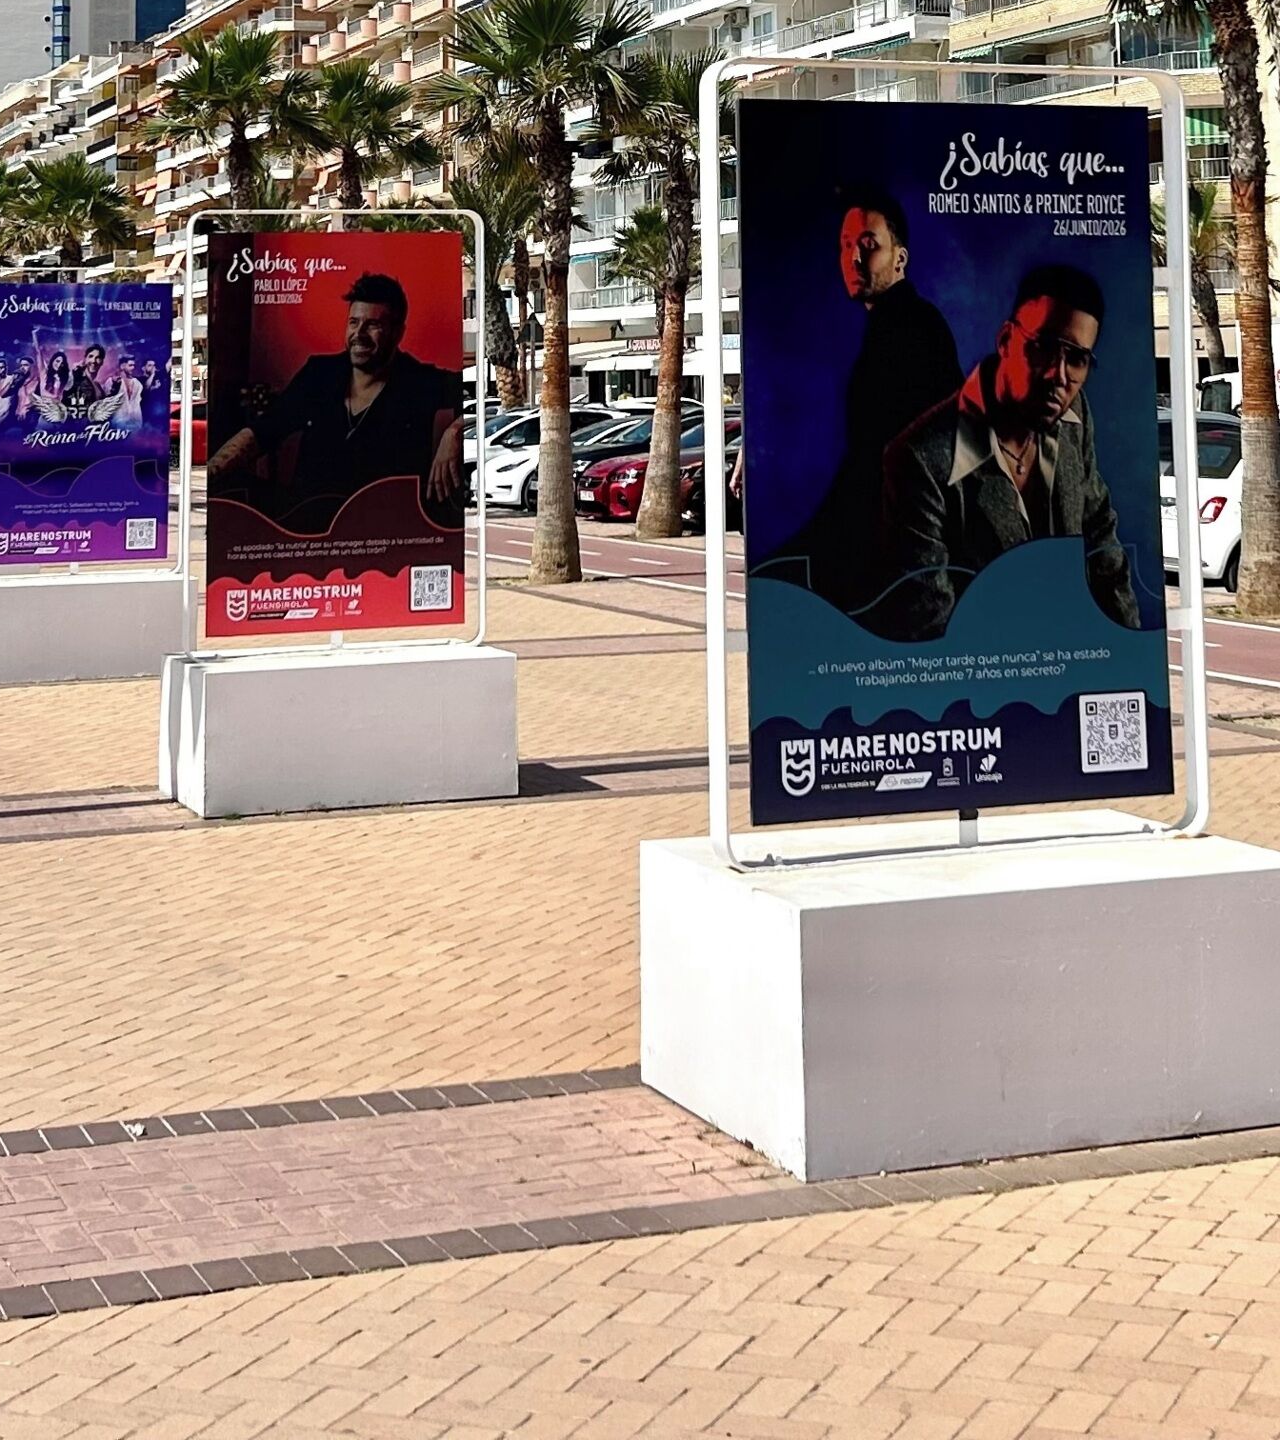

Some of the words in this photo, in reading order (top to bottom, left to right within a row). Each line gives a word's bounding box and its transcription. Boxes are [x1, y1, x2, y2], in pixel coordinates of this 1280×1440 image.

[939, 132, 1050, 191] ¿Sabías
[1059, 151, 1125, 185] que...
[928, 192, 970, 214] ROMEO
[972, 193, 1021, 214] SANTOS
[1023, 194, 1034, 214] &
[1036, 194, 1084, 215] PRINCE
[1087, 194, 1126, 215] ROYCE
[1053, 219, 1127, 236] 26/JUNIO/2026
[226, 247, 297, 283] ¿Sabías
[304, 257, 347, 278] que...
[254, 279, 280, 292] PABLO
[281, 277, 308, 292] LÓPEZ
[84, 421, 131, 447] Flow
[818, 662, 828, 674] el
[831, 661, 866, 673] nuevo
[945, 654, 975, 667] tarde
[977, 656, 1000, 666] que
[1042, 652, 1055, 661] se
[1057, 649, 1071, 661] ha
[1073, 647, 1111, 659] estado
[855, 671, 917, 687] trabajando
[919, 670, 964, 683] durante
[966, 668, 973, 680] 7
[975, 667, 1002, 680] años
[1004, 667, 1019, 678] en
[1020, 663, 1066, 677] secreto?
[821, 757, 916, 776] FUENGIROLA
